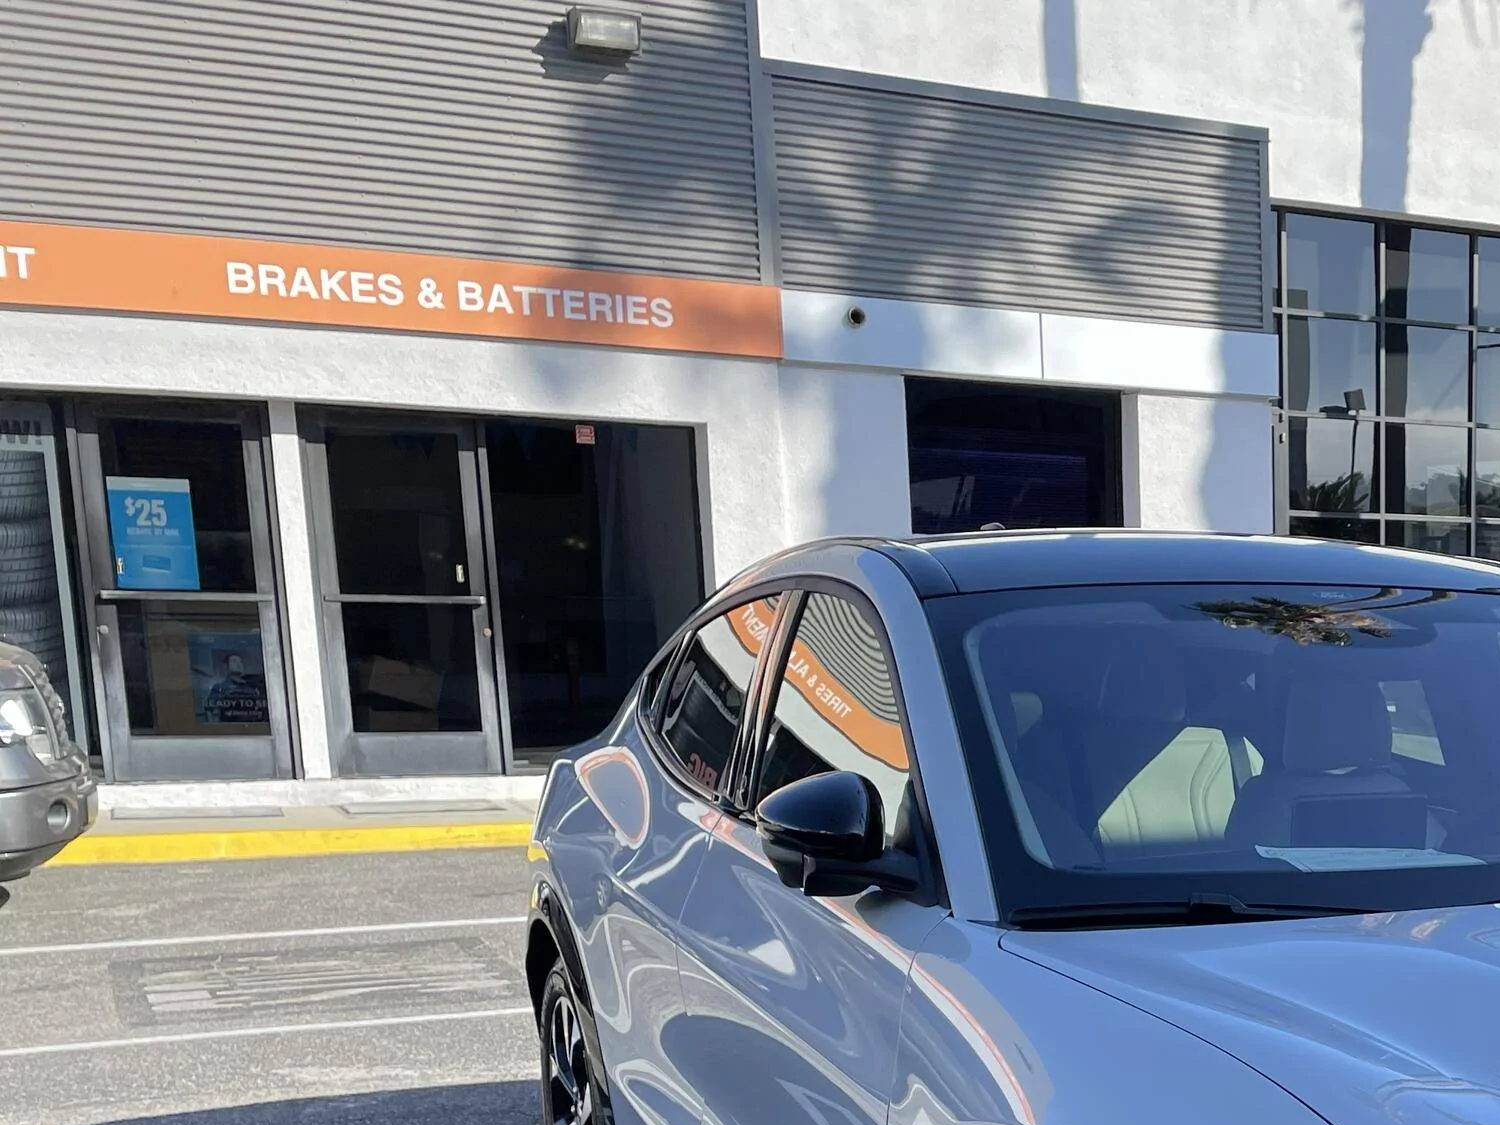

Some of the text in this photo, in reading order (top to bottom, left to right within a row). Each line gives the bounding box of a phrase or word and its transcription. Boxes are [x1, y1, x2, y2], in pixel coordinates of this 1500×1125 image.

[0, 245, 36, 280] T
[226, 261, 674, 328] BRAKES & BATTERIES
[124, 496, 168, 528] $25
